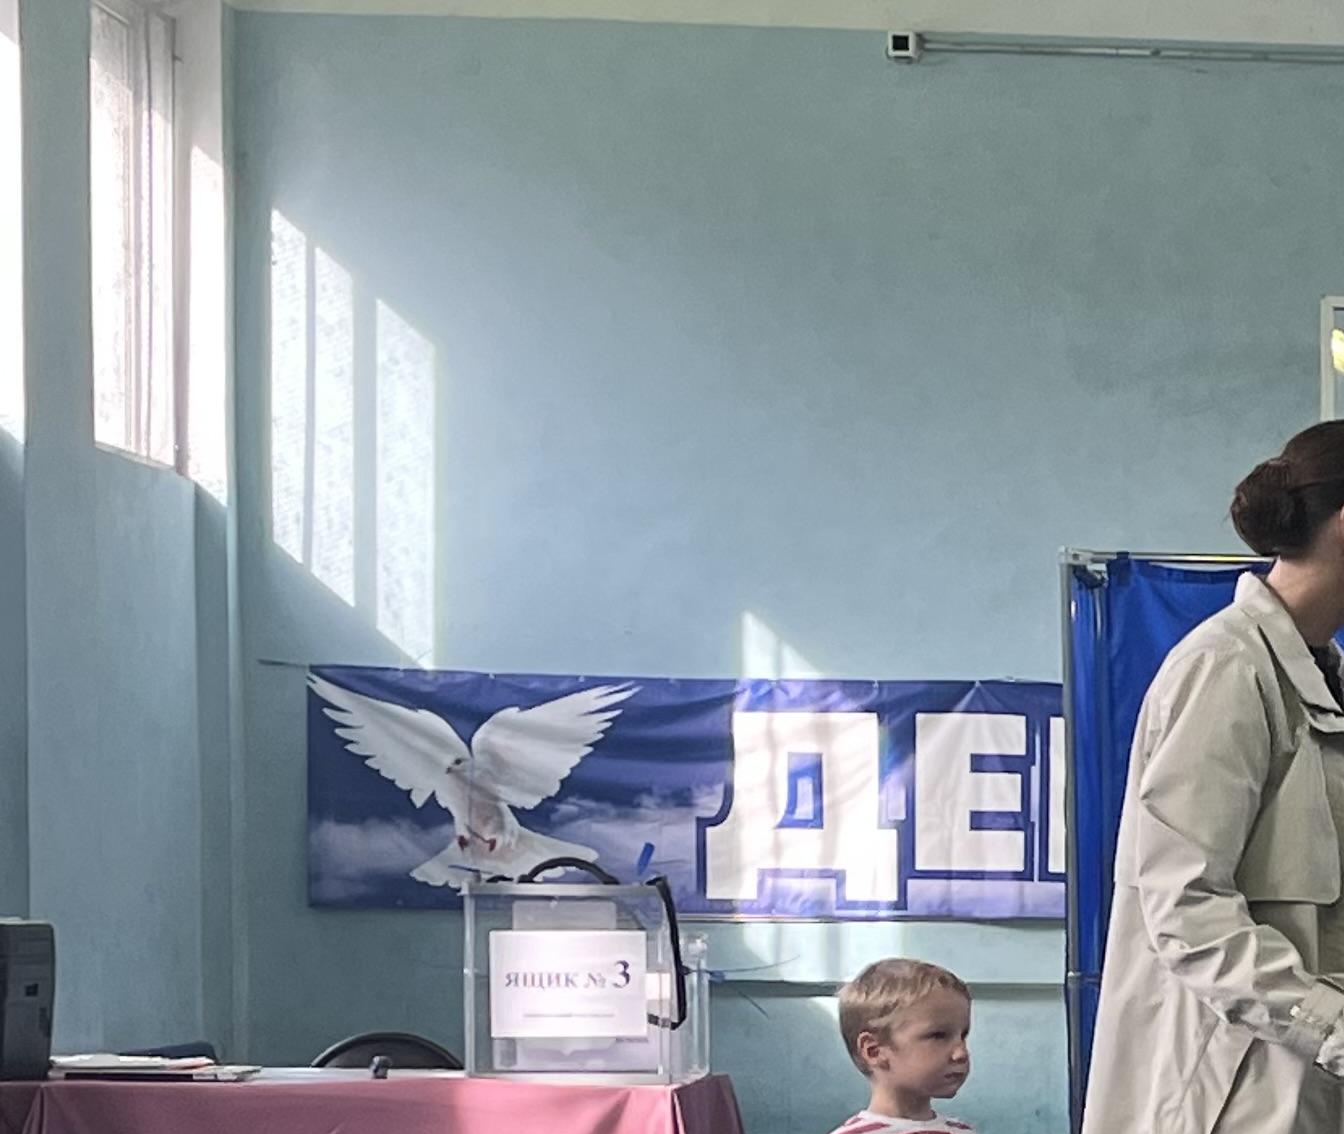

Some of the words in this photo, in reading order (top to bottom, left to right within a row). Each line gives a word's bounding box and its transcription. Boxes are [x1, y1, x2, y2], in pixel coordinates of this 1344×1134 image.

[705, 711, 1065, 900] ДЕ
[504, 971, 579, 990] ЯЩИК
[583, 972, 607, 989] №
[612, 959, 631, 989] 3
